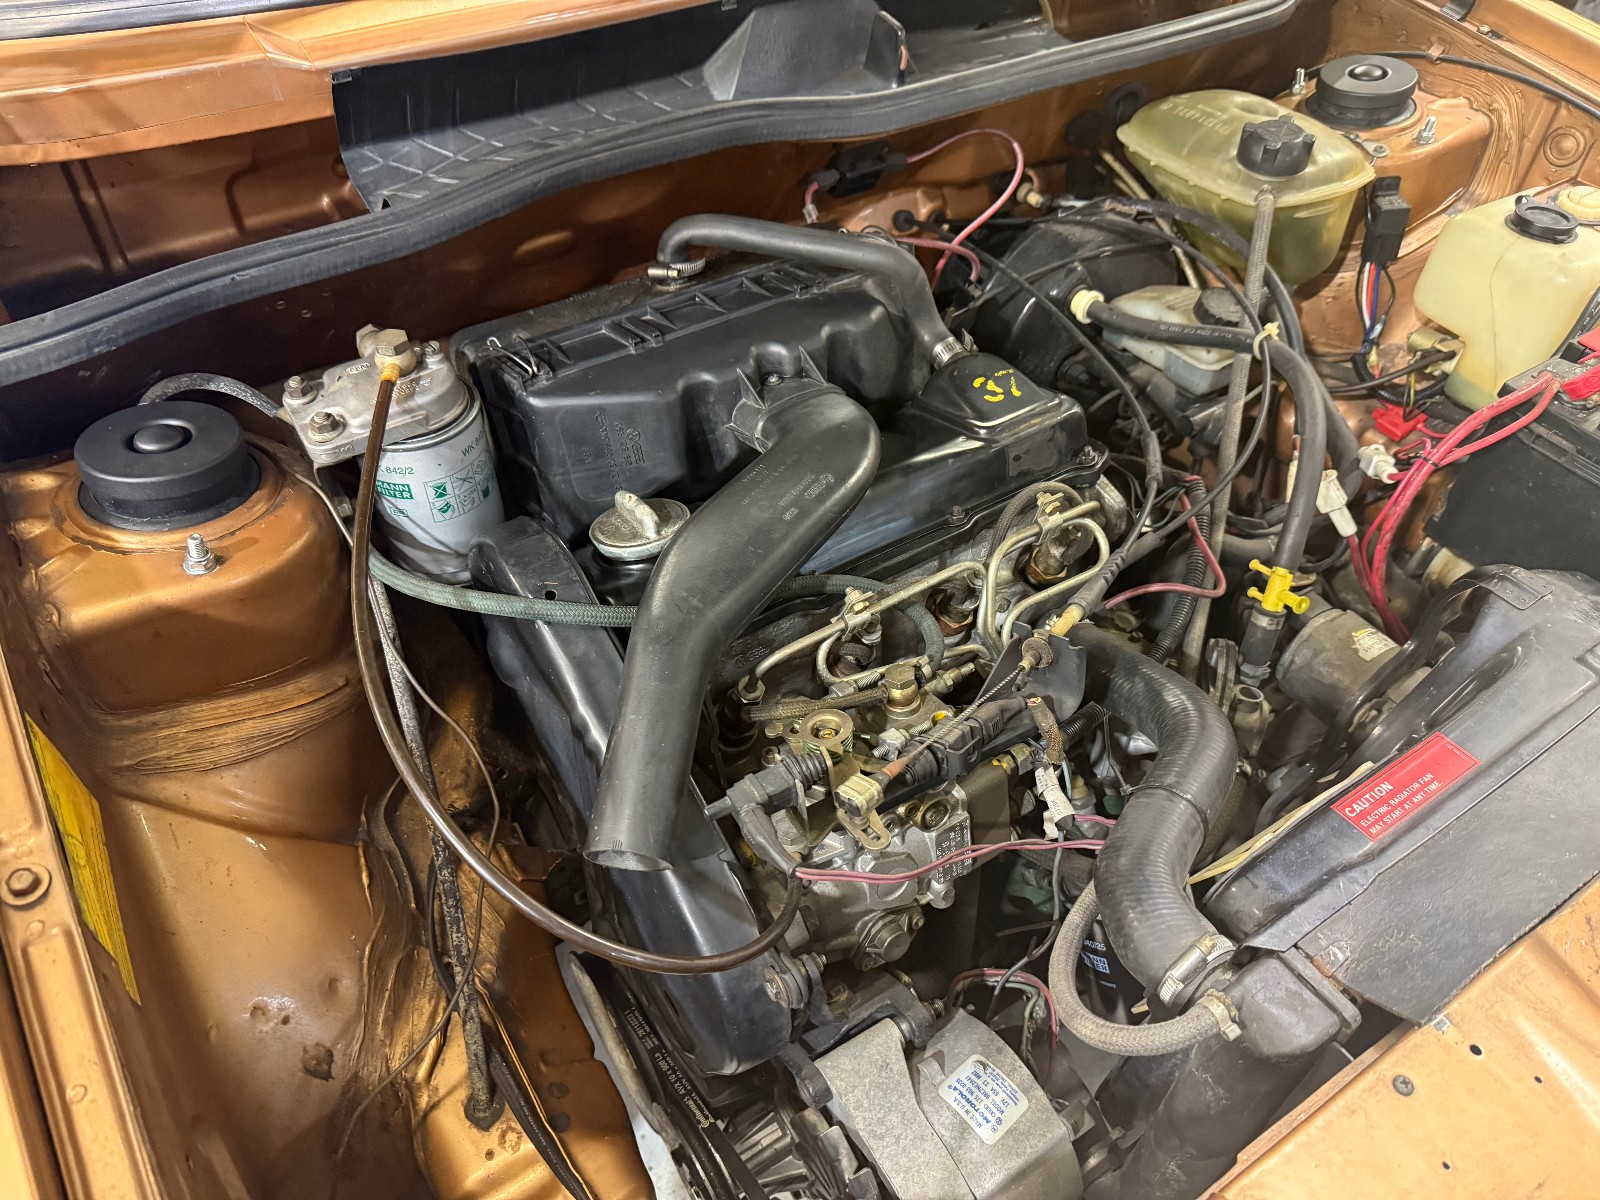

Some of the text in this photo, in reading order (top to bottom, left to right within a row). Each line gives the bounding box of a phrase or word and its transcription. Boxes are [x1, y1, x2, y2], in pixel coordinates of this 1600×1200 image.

[461, 444, 475, 457] WK
[385, 466, 415, 475] 842/2
[1345, 781, 1393, 817] CAUTION
[1360, 773, 1434, 827] ELECTRIC RADIATOR FAN
[1369, 780, 1443, 835] MAY START AT ANY TIME.
[668, 1073, 677, 1082] 10
[673, 1080, 686, 1095] AVX
[952, 1085, 991, 1124] MOTOROLA
[988, 1098, 1005, 1115] MODEL
